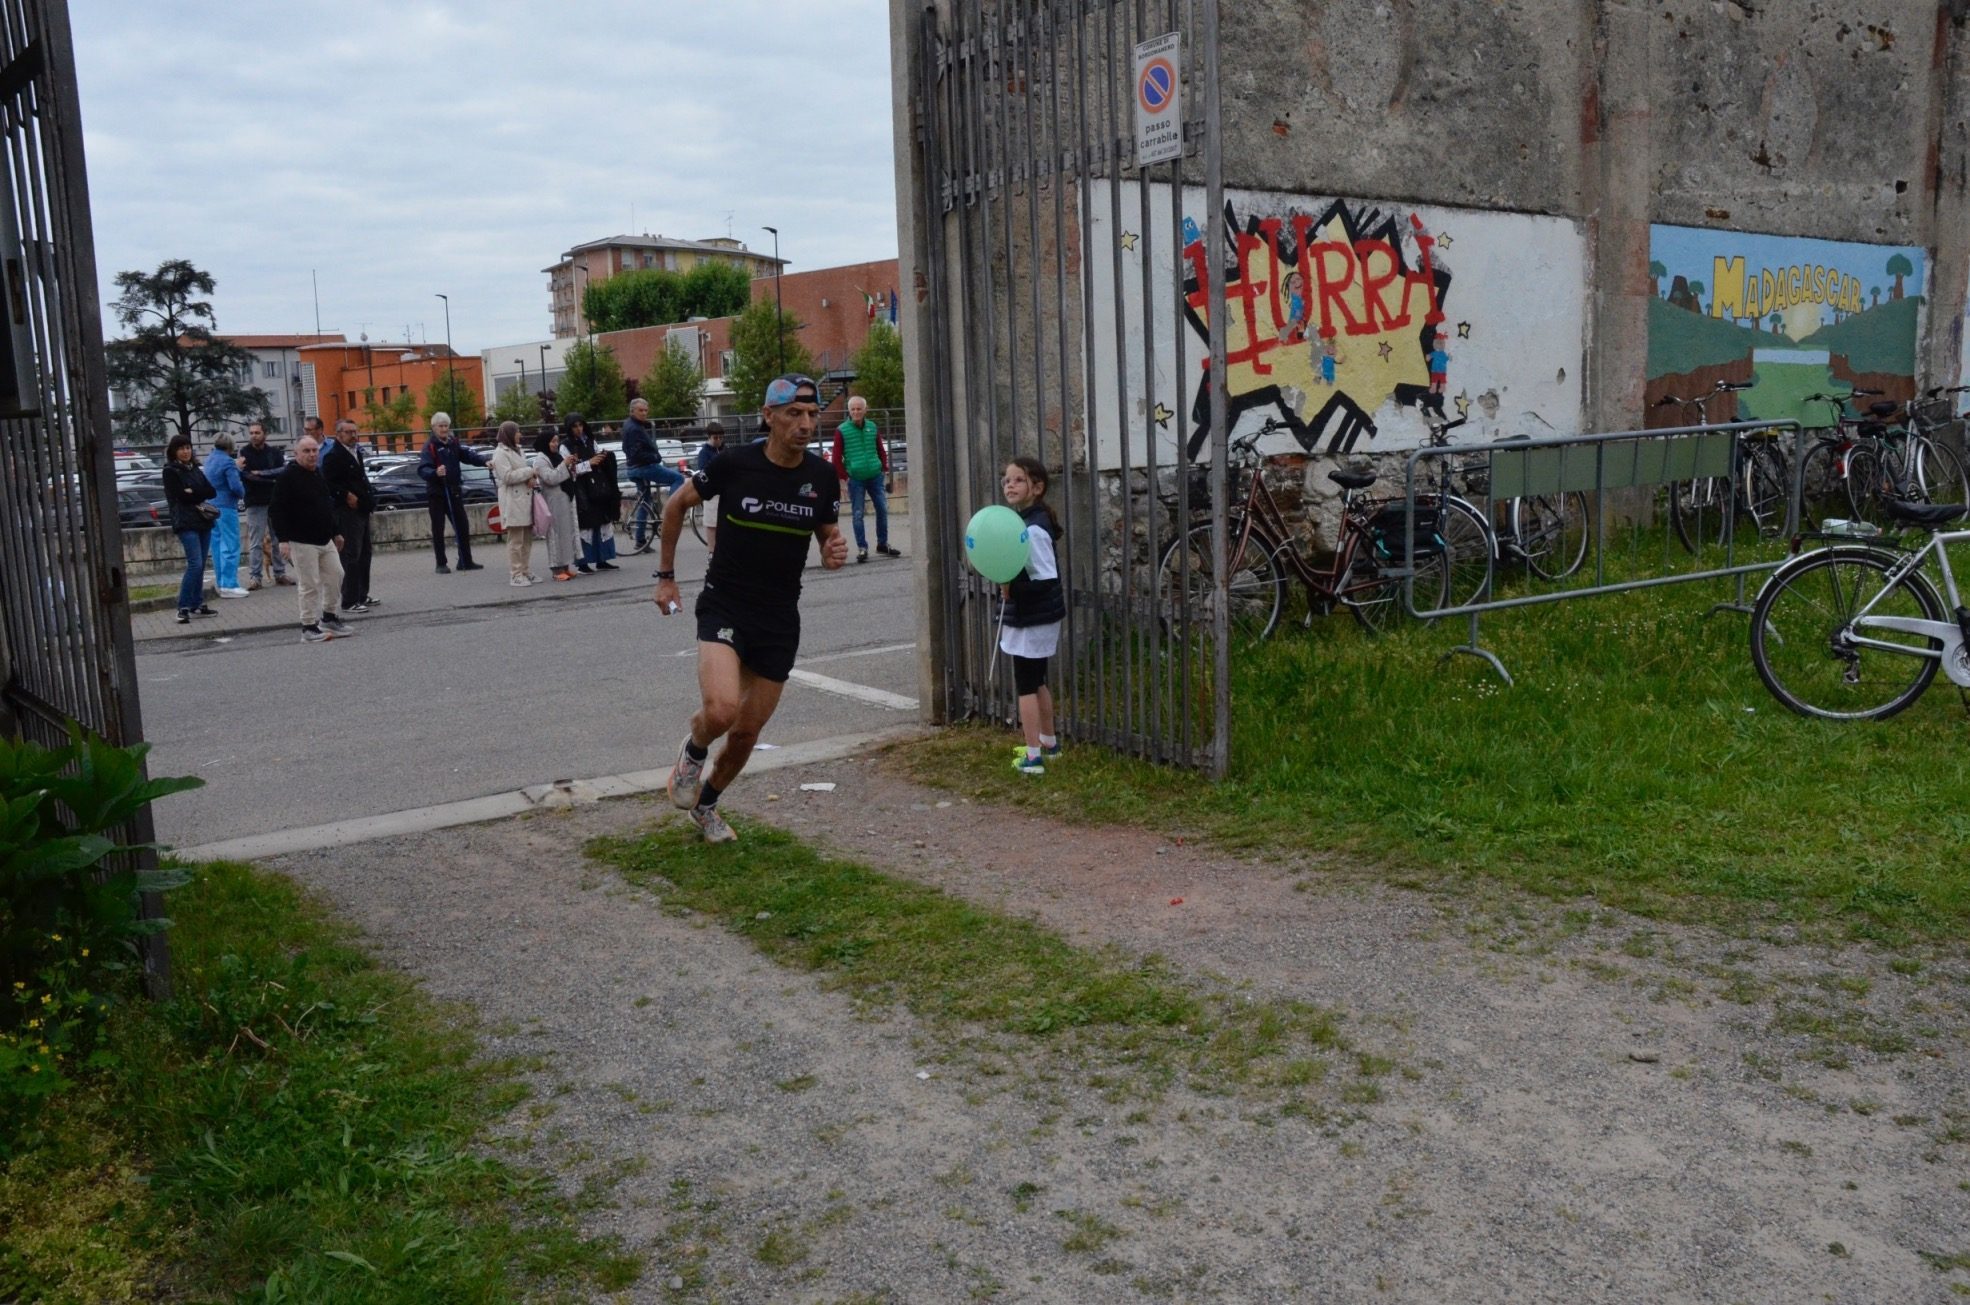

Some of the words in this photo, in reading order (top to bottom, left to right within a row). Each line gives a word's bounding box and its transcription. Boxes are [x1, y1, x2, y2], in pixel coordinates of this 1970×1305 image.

[1145, 120, 1171, 135] passo
[1140, 131, 1178, 149] carrabile
[765, 500, 813, 518] POLETTI
